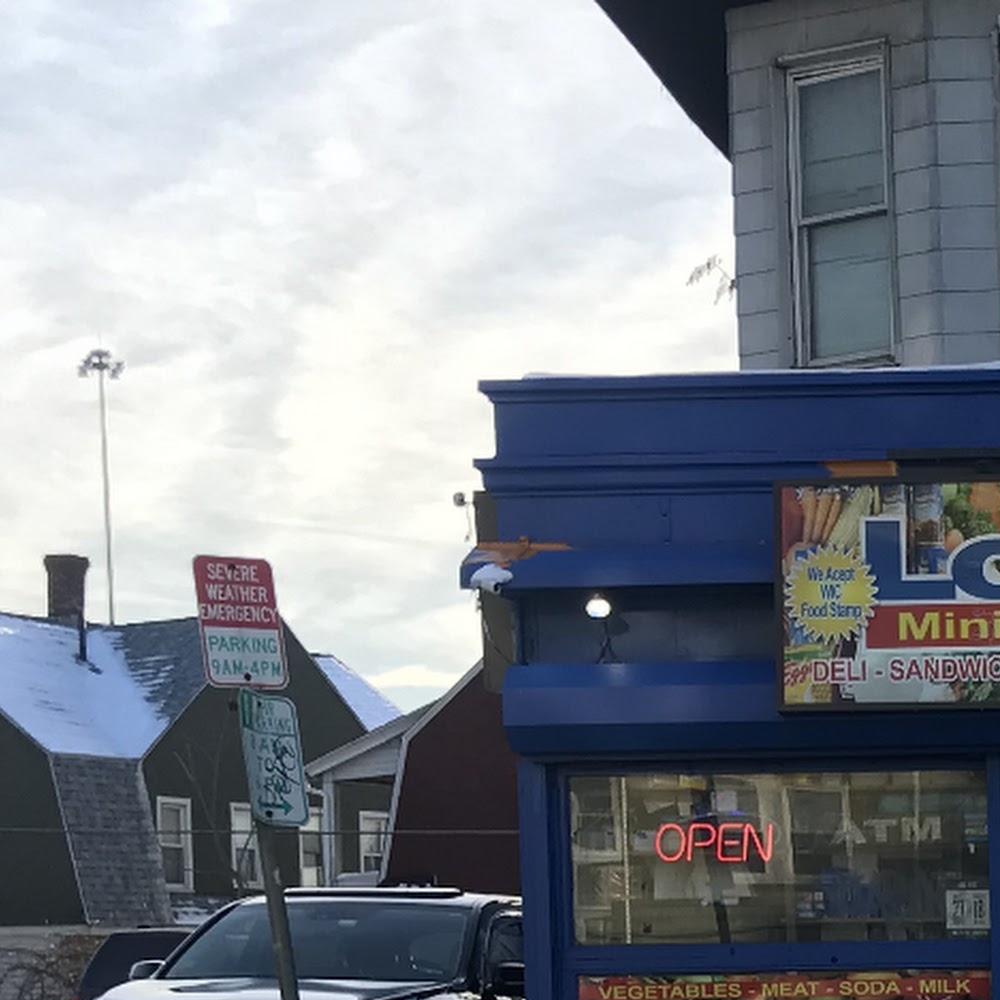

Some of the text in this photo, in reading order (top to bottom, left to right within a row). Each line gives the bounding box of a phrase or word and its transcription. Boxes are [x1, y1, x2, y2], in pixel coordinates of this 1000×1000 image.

[207, 563, 259, 583] SEVERE
[808, 567, 856, 584] We Acept
[206, 584, 268, 603] WEATHER
[200, 603, 278, 624] EMERGENCY
[801, 602, 861, 620] Food Stamp
[207, 635, 278, 655] PARKING
[211, 659, 281, 677] 9AM-4PM
[813, 660, 867, 682] DELI
[829, 816, 943, 845] ATM
[655, 822, 774, 863] OPEN
[599, 983, 742, 1000] VEGETABLES
[761, 981, 819, 997] MEAT
[839, 981, 900, 996] SODA
[919, 979, 971, 995] MILK
